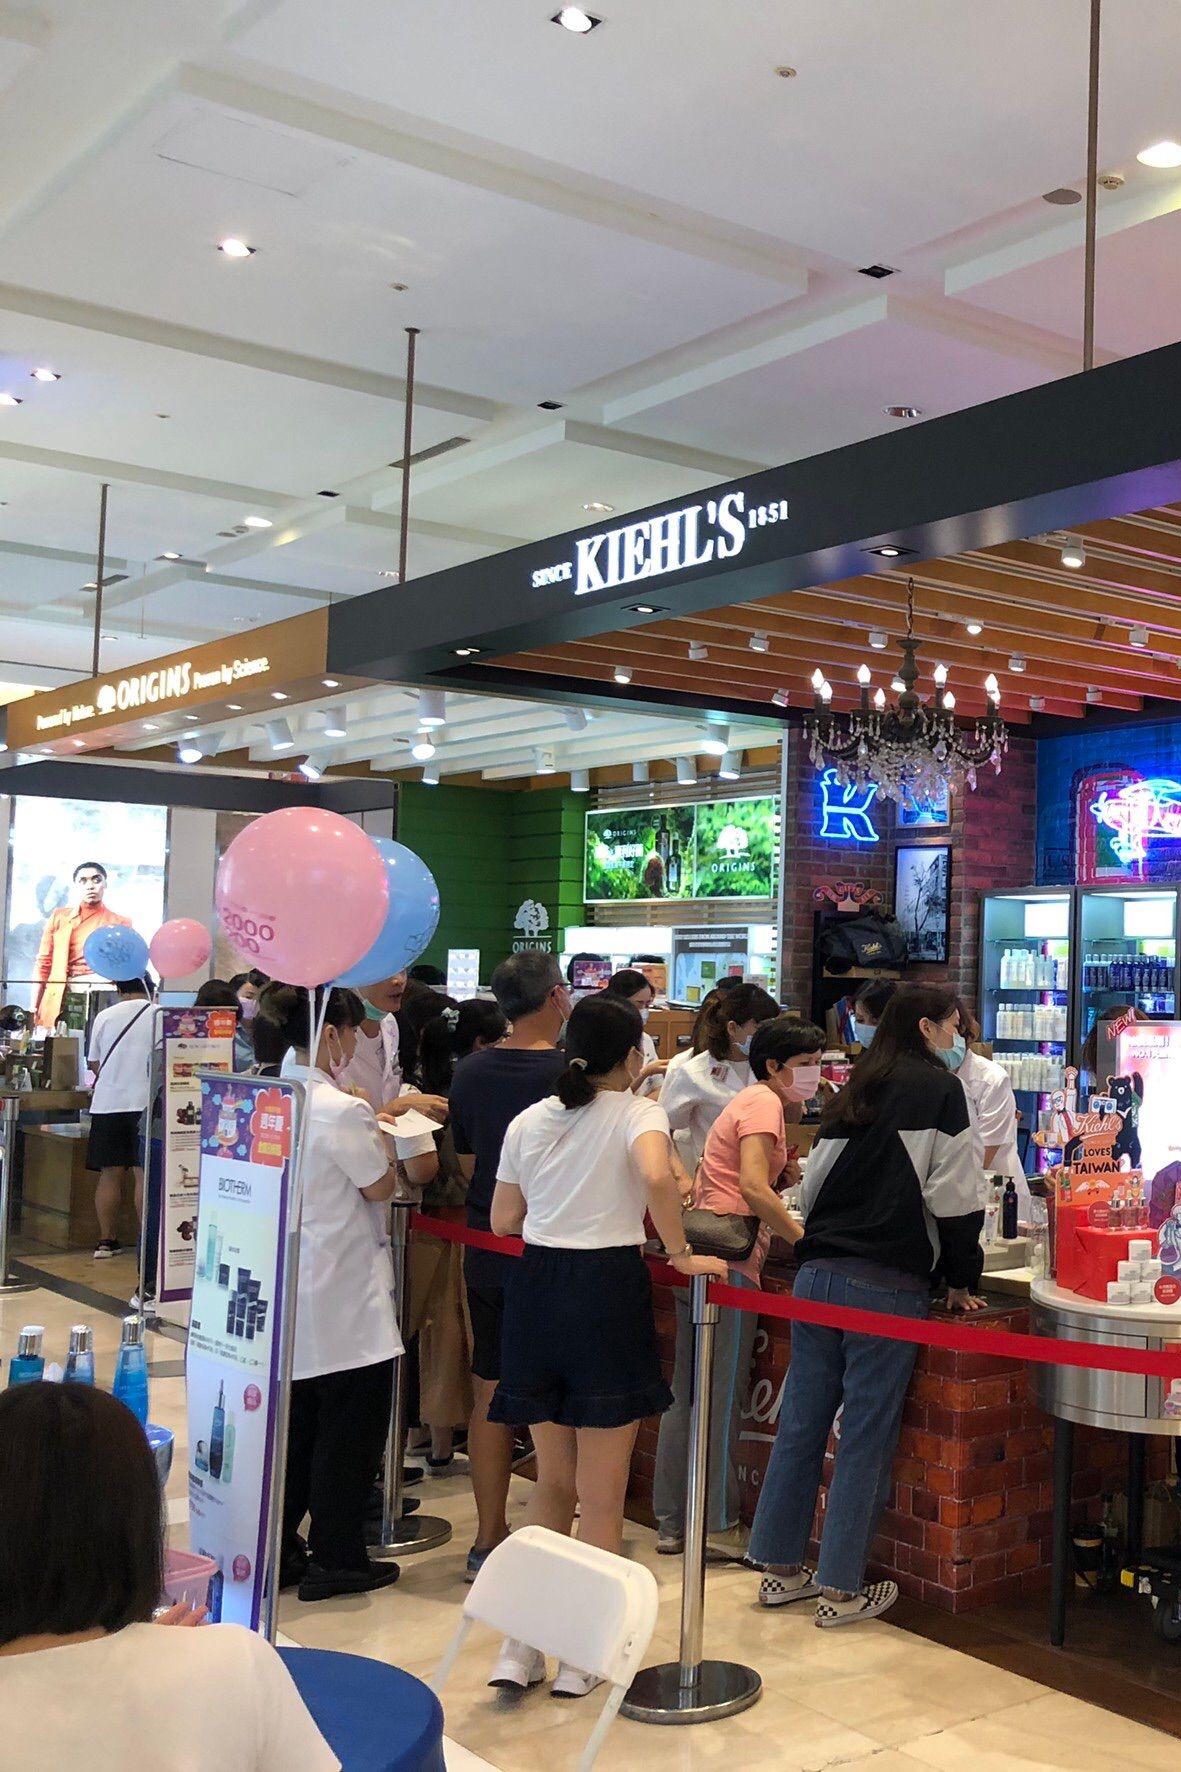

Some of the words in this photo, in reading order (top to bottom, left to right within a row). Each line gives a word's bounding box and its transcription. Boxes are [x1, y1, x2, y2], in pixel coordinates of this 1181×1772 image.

[532, 561, 573, 588] SINCE
[574, 491, 746, 596] KIEHL'S
[748, 500, 789, 530] 1851
[117, 662, 192, 710] ORIGINS
[711, 861, 756, 873] ORIGINS
[512, 941, 552, 954] ORIGINS
[1106, 1006, 1135, 1041] NEW!
[1073, 1113, 1123, 1136] Kiehl's
[1084, 1147, 1111, 1158] LOVES
[1073, 1160, 1121, 1175] TAIWAN
[218, 1176, 252, 1197] BIOTHERM
